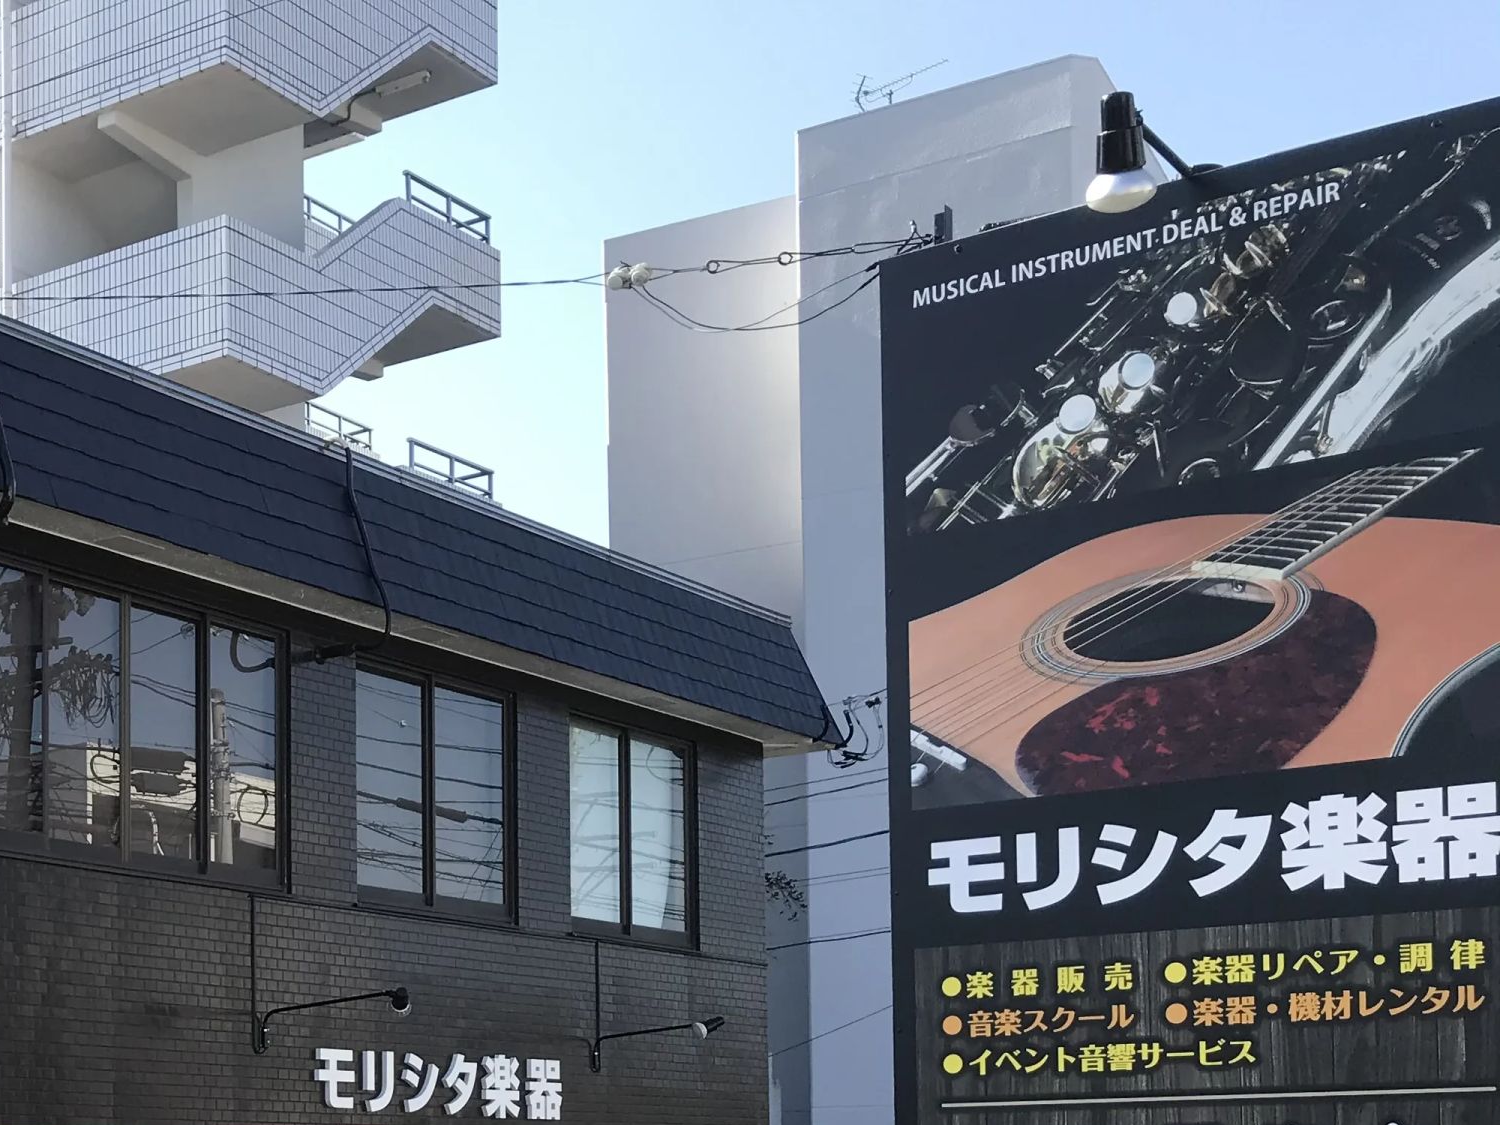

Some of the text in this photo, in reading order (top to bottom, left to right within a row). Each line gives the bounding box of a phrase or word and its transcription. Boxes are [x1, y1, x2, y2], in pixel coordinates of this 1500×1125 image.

[912, 182, 1340, 309] MUSICAL INSTRUMENT DEAL & REPAIR
[927, 781, 1500, 913] モリシタ楽器
[966, 961, 1134, 999] 楽器販売
[1192, 938, 1486, 986] 楽器リペア・調律
[967, 1004, 1135, 1038] 音楽スクール
[1192, 984, 1486, 1027] 楽器・機材レンタル
[968, 1039, 1257, 1077] イベント音響サービス
[314, 1047, 564, 1121] モリシタ楽器
